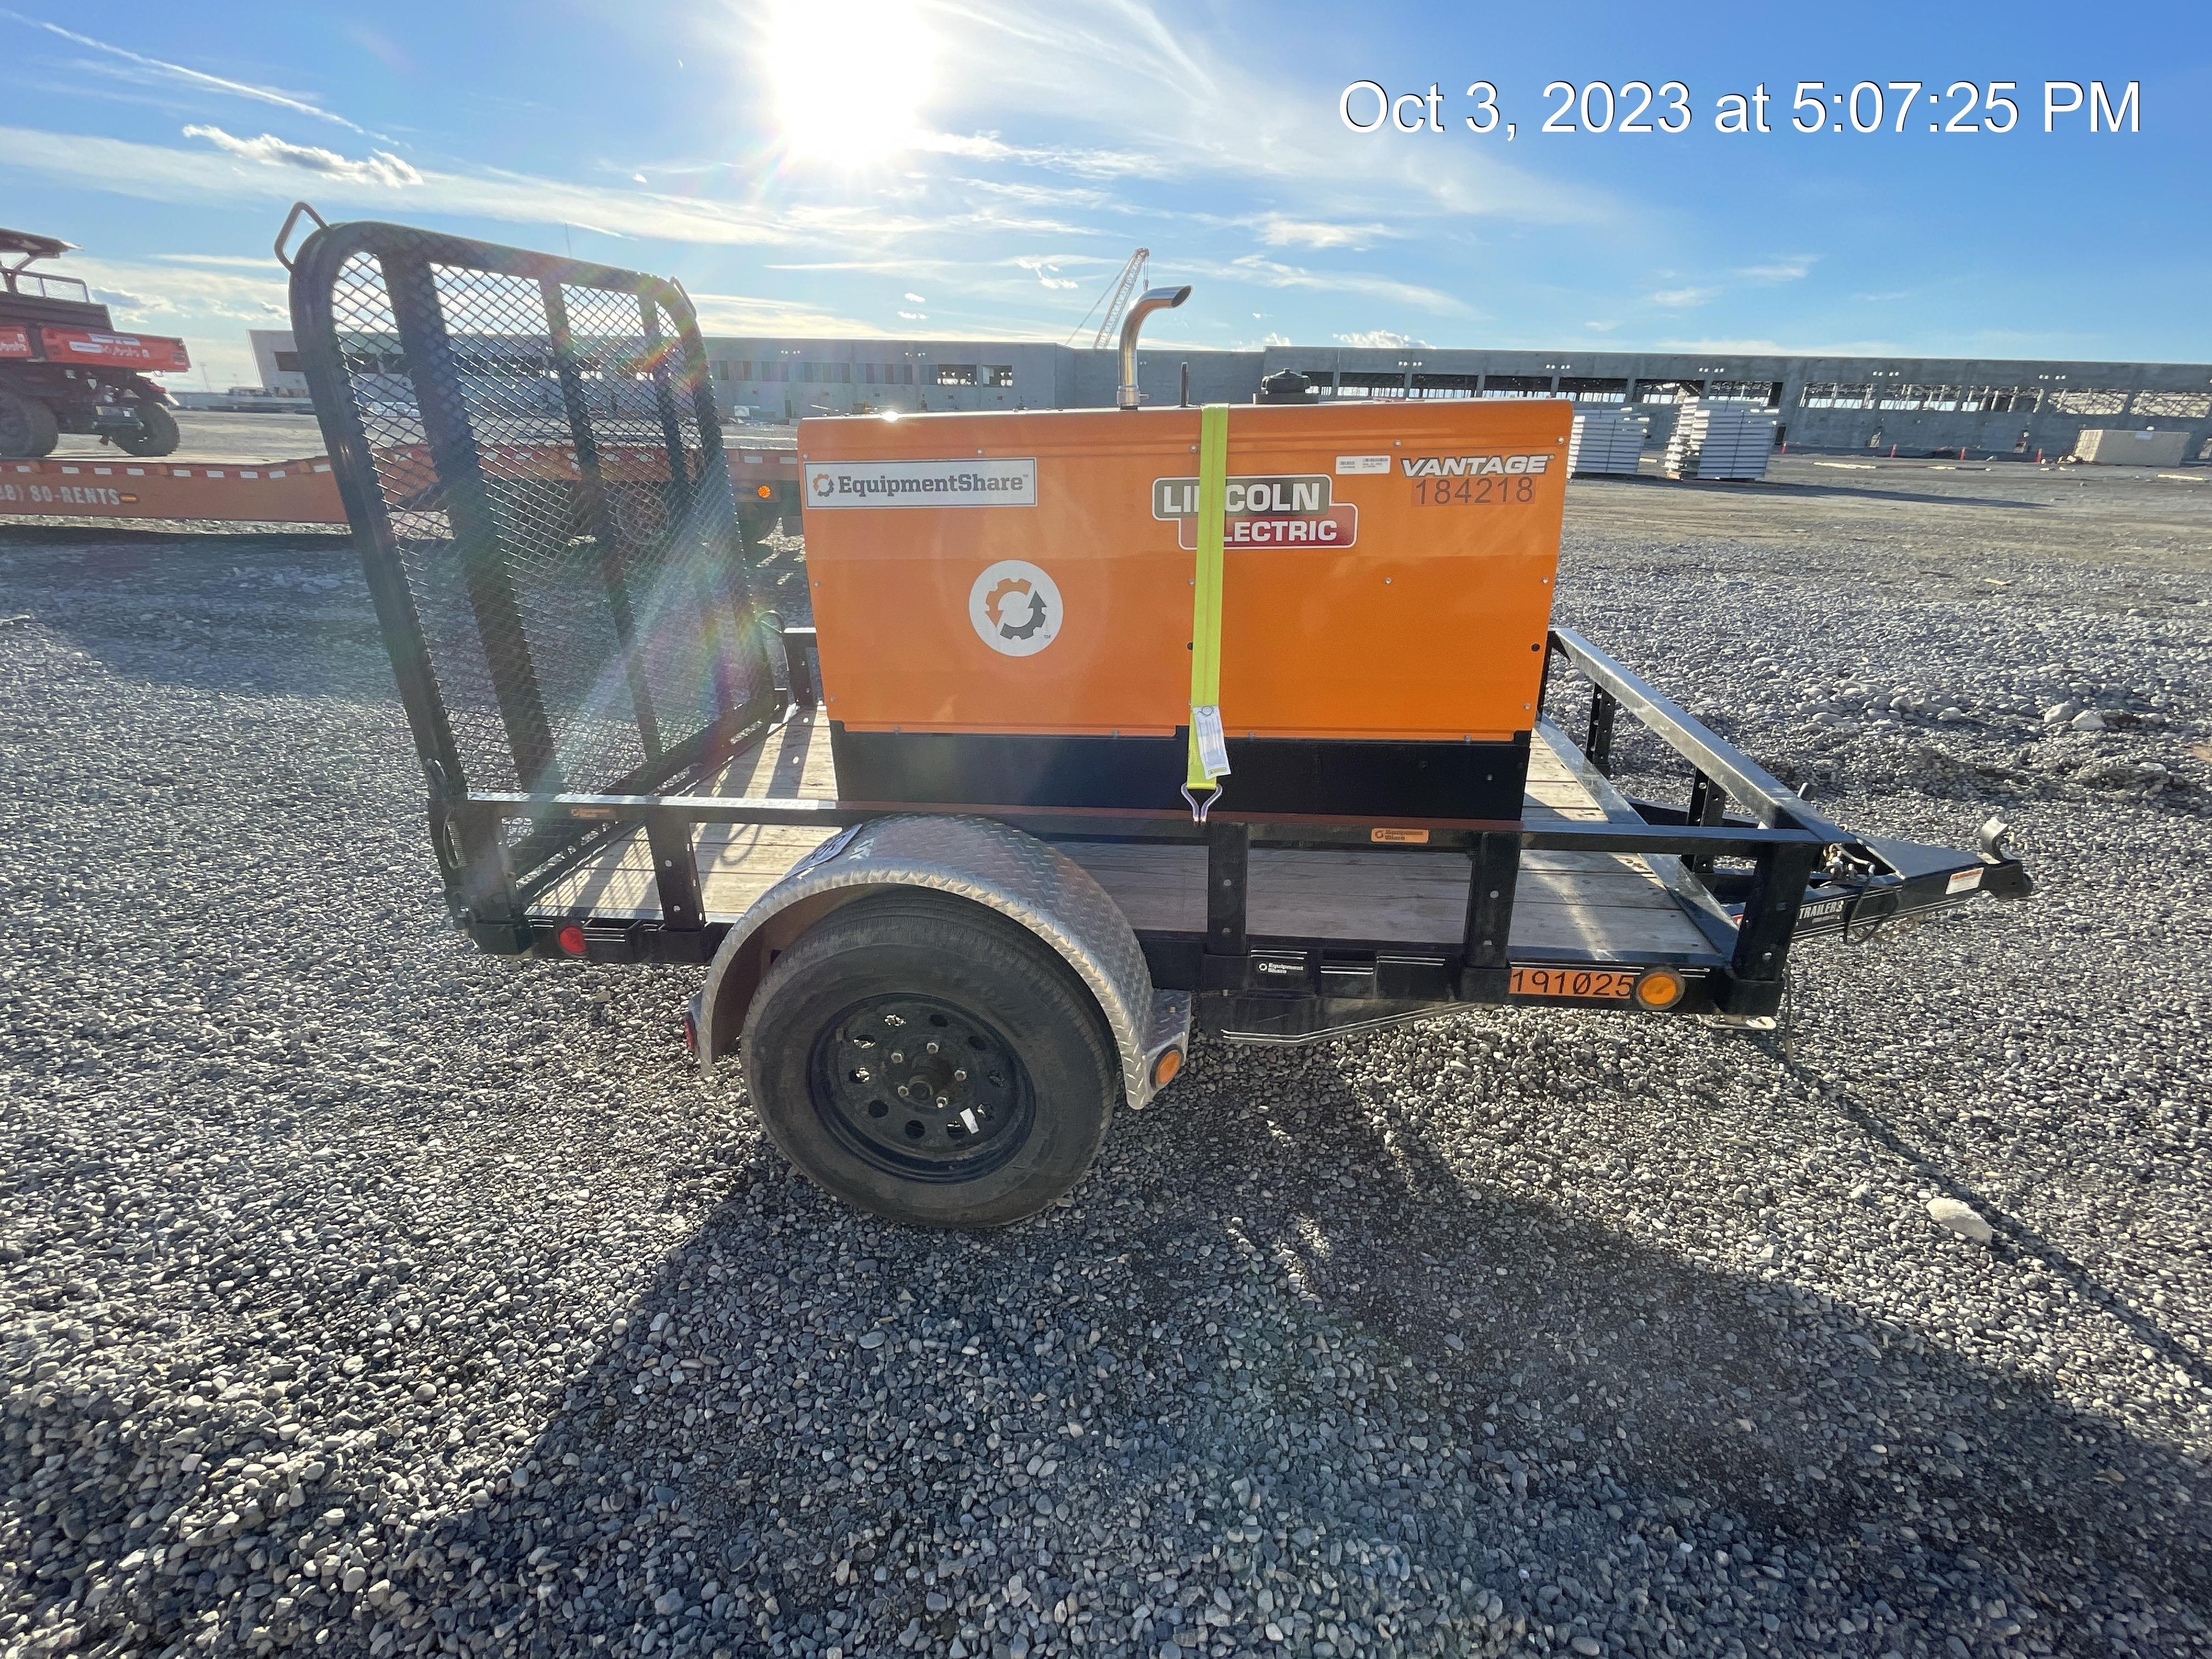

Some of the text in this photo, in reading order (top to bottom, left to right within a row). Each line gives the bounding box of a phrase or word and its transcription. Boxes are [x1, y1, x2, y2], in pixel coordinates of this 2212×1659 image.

[1402, 455, 1549, 477] VANTAGE
[838, 474, 1024, 497] EquipmentShare
[1415, 476, 1533, 505] 184218
[1163, 483, 1321, 513] LICOLN
[1223, 520, 1338, 542] ECTRIC
[1513, 970, 1635, 996] 191025
